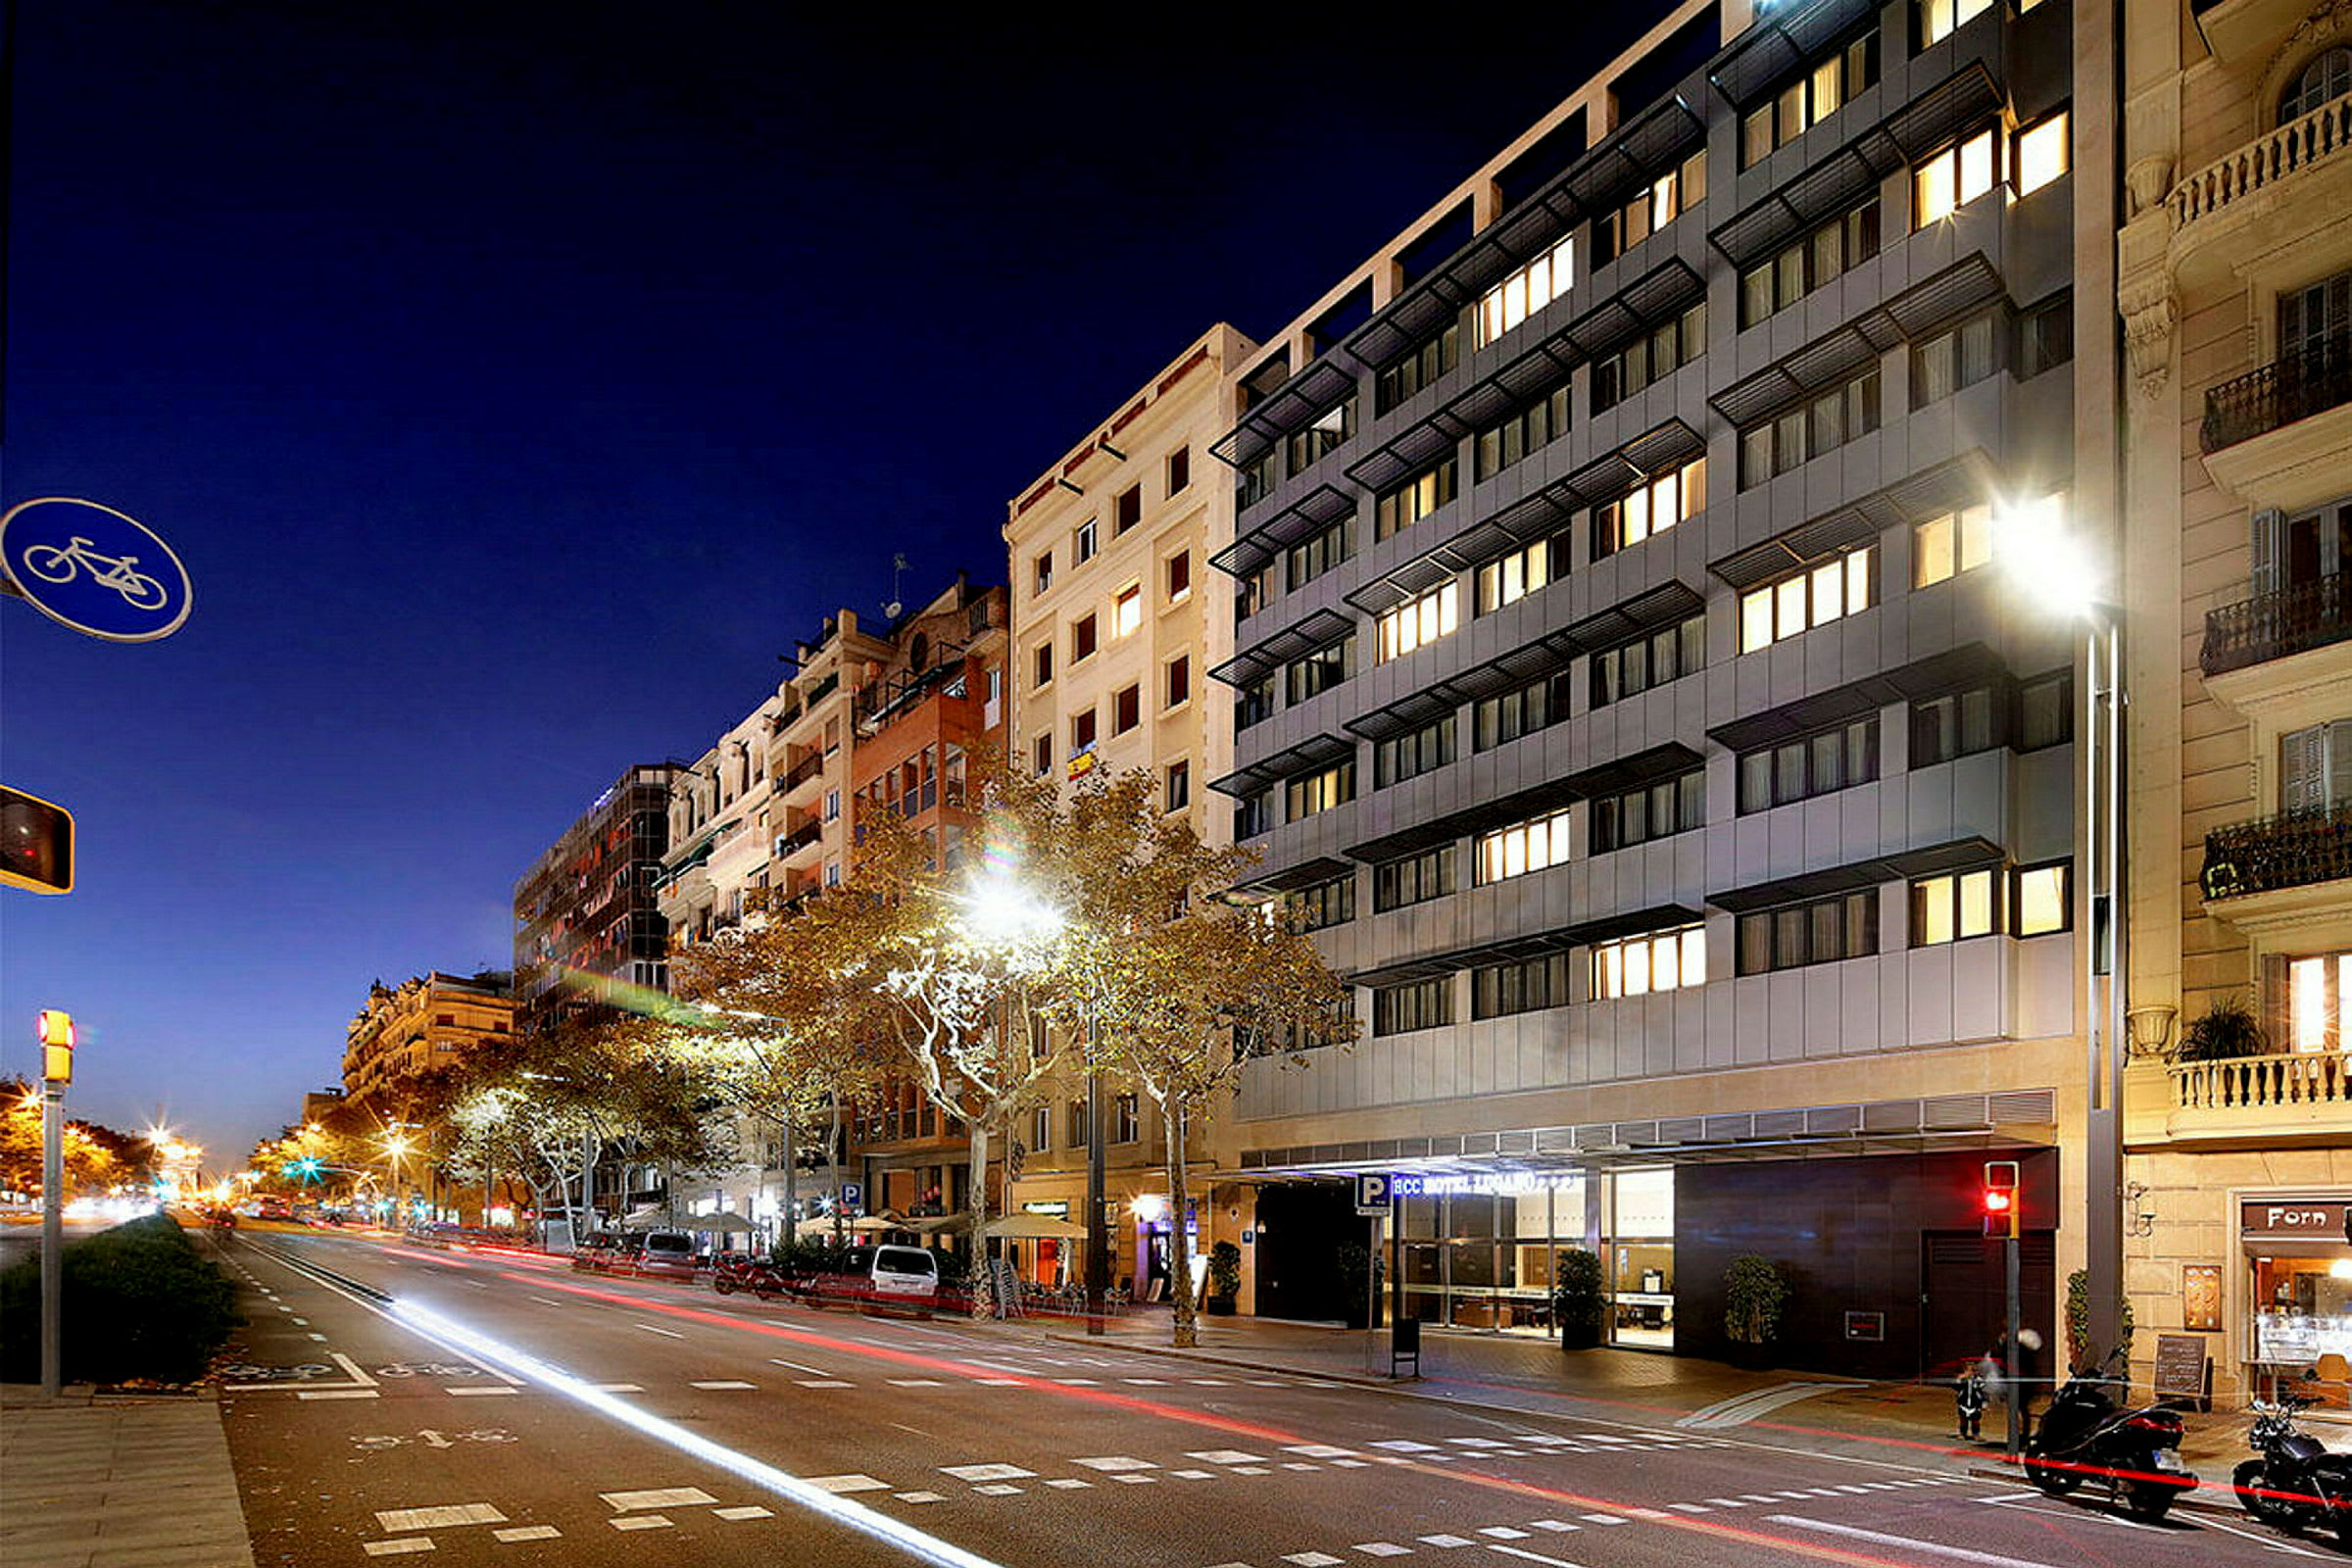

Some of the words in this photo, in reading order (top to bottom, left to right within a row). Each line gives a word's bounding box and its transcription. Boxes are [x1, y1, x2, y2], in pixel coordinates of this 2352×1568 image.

[845, 1186, 858, 1202] P
[1363, 1177, 1385, 1204] P
[2268, 1207, 2327, 1228] Forn
